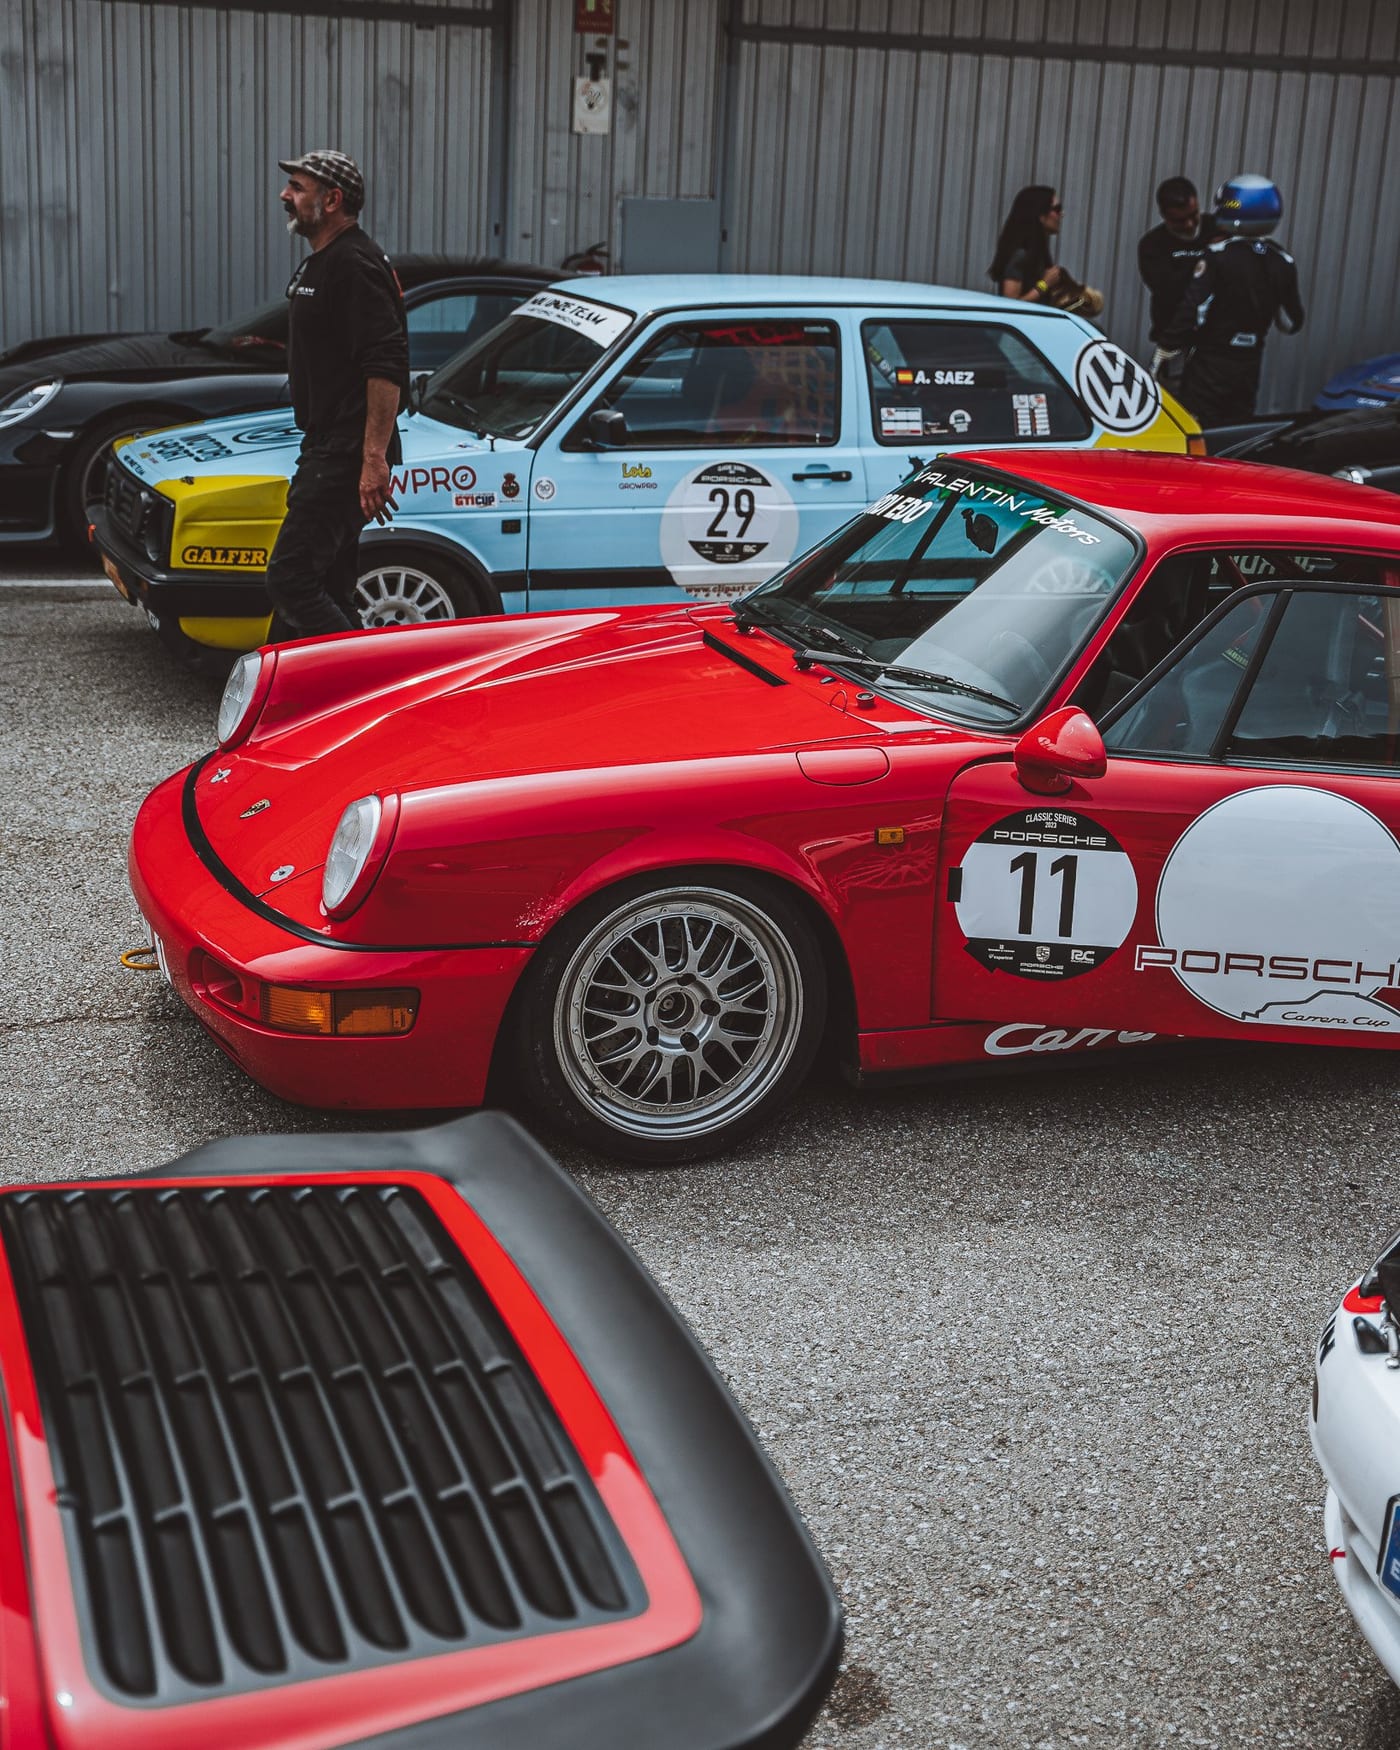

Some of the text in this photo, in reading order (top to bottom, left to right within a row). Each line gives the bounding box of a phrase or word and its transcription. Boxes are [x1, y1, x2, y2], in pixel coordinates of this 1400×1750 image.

[914, 369, 975, 386] A. SAEZ
[622, 462, 652, 479] Lois
[700, 474, 763, 485] PORSCHE
[389, 465, 477, 496] WPRO
[913, 470, 1027, 512] VALENTIN
[706, 487, 755, 538] 29
[1020, 507, 1101, 545] Motors
[183, 547, 266, 566] GALFER
[1025, 812, 1078, 827] CLASSIC SERIES
[993, 830, 1107, 847] PORSCHE
[1009, 851, 1079, 939] 11
[1019, 962, 1064, 971] PORSCHE
[1134, 944, 1400, 988] PORSCH
[1280, 1011, 1391, 1028] Carrera Cup
